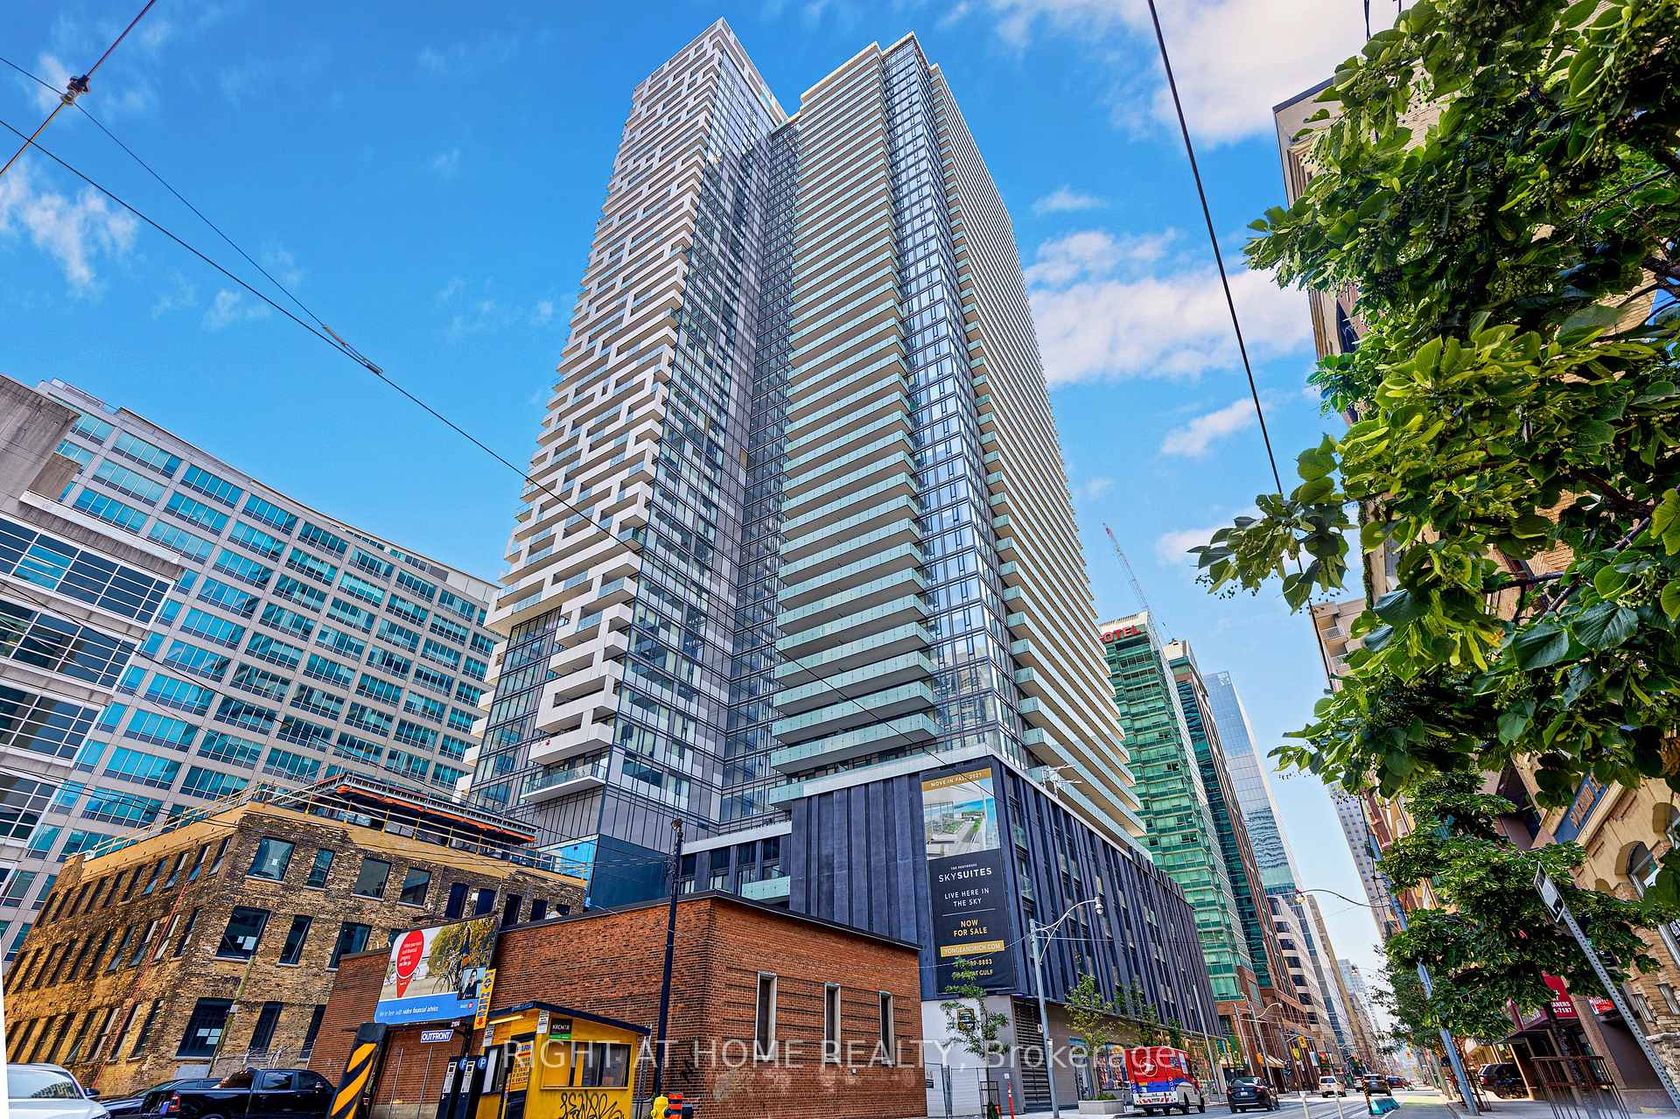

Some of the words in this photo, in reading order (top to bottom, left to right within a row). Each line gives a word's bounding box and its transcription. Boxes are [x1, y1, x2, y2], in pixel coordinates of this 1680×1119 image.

[938, 867, 992, 883] SKYSUITES
[944, 891, 959, 900] LIVE
[961, 888, 979, 897] HERE
[953, 899, 967, 907] THE
[969, 897, 982, 906] SKY
[960, 919, 979, 928] NOW
[953, 929, 968, 937] FOR
[969, 926, 988, 936] SALE
[421, 1031, 451, 1041] OUTFRONT
